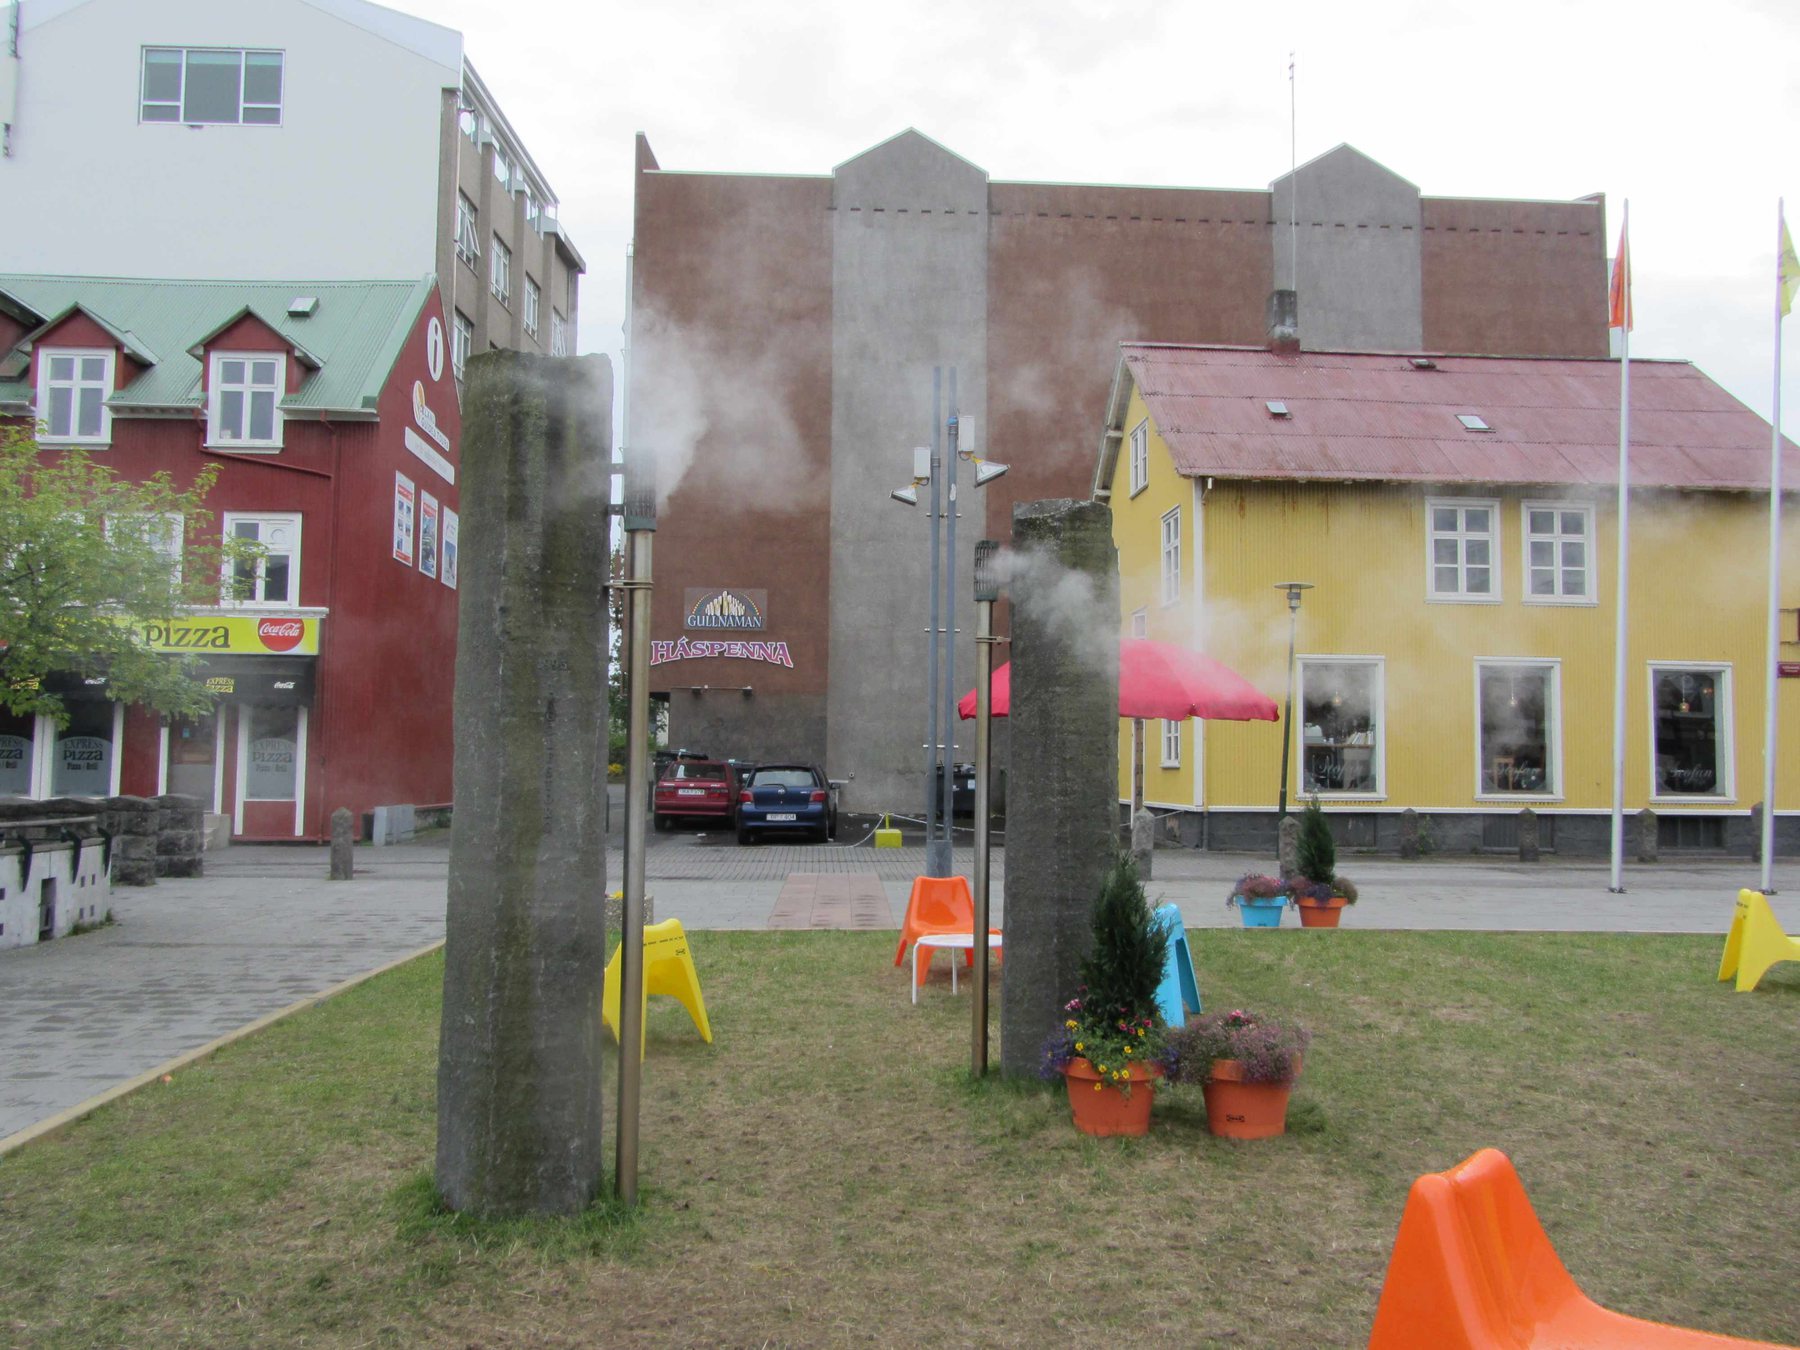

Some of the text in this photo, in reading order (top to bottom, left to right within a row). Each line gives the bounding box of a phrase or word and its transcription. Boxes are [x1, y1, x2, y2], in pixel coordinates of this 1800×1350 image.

[145, 624, 231, 649] pizza
[651, 636, 793, 668] HÁSPENNA
[0, 748, 23, 760] zza
[63, 749, 104, 761] pizza
